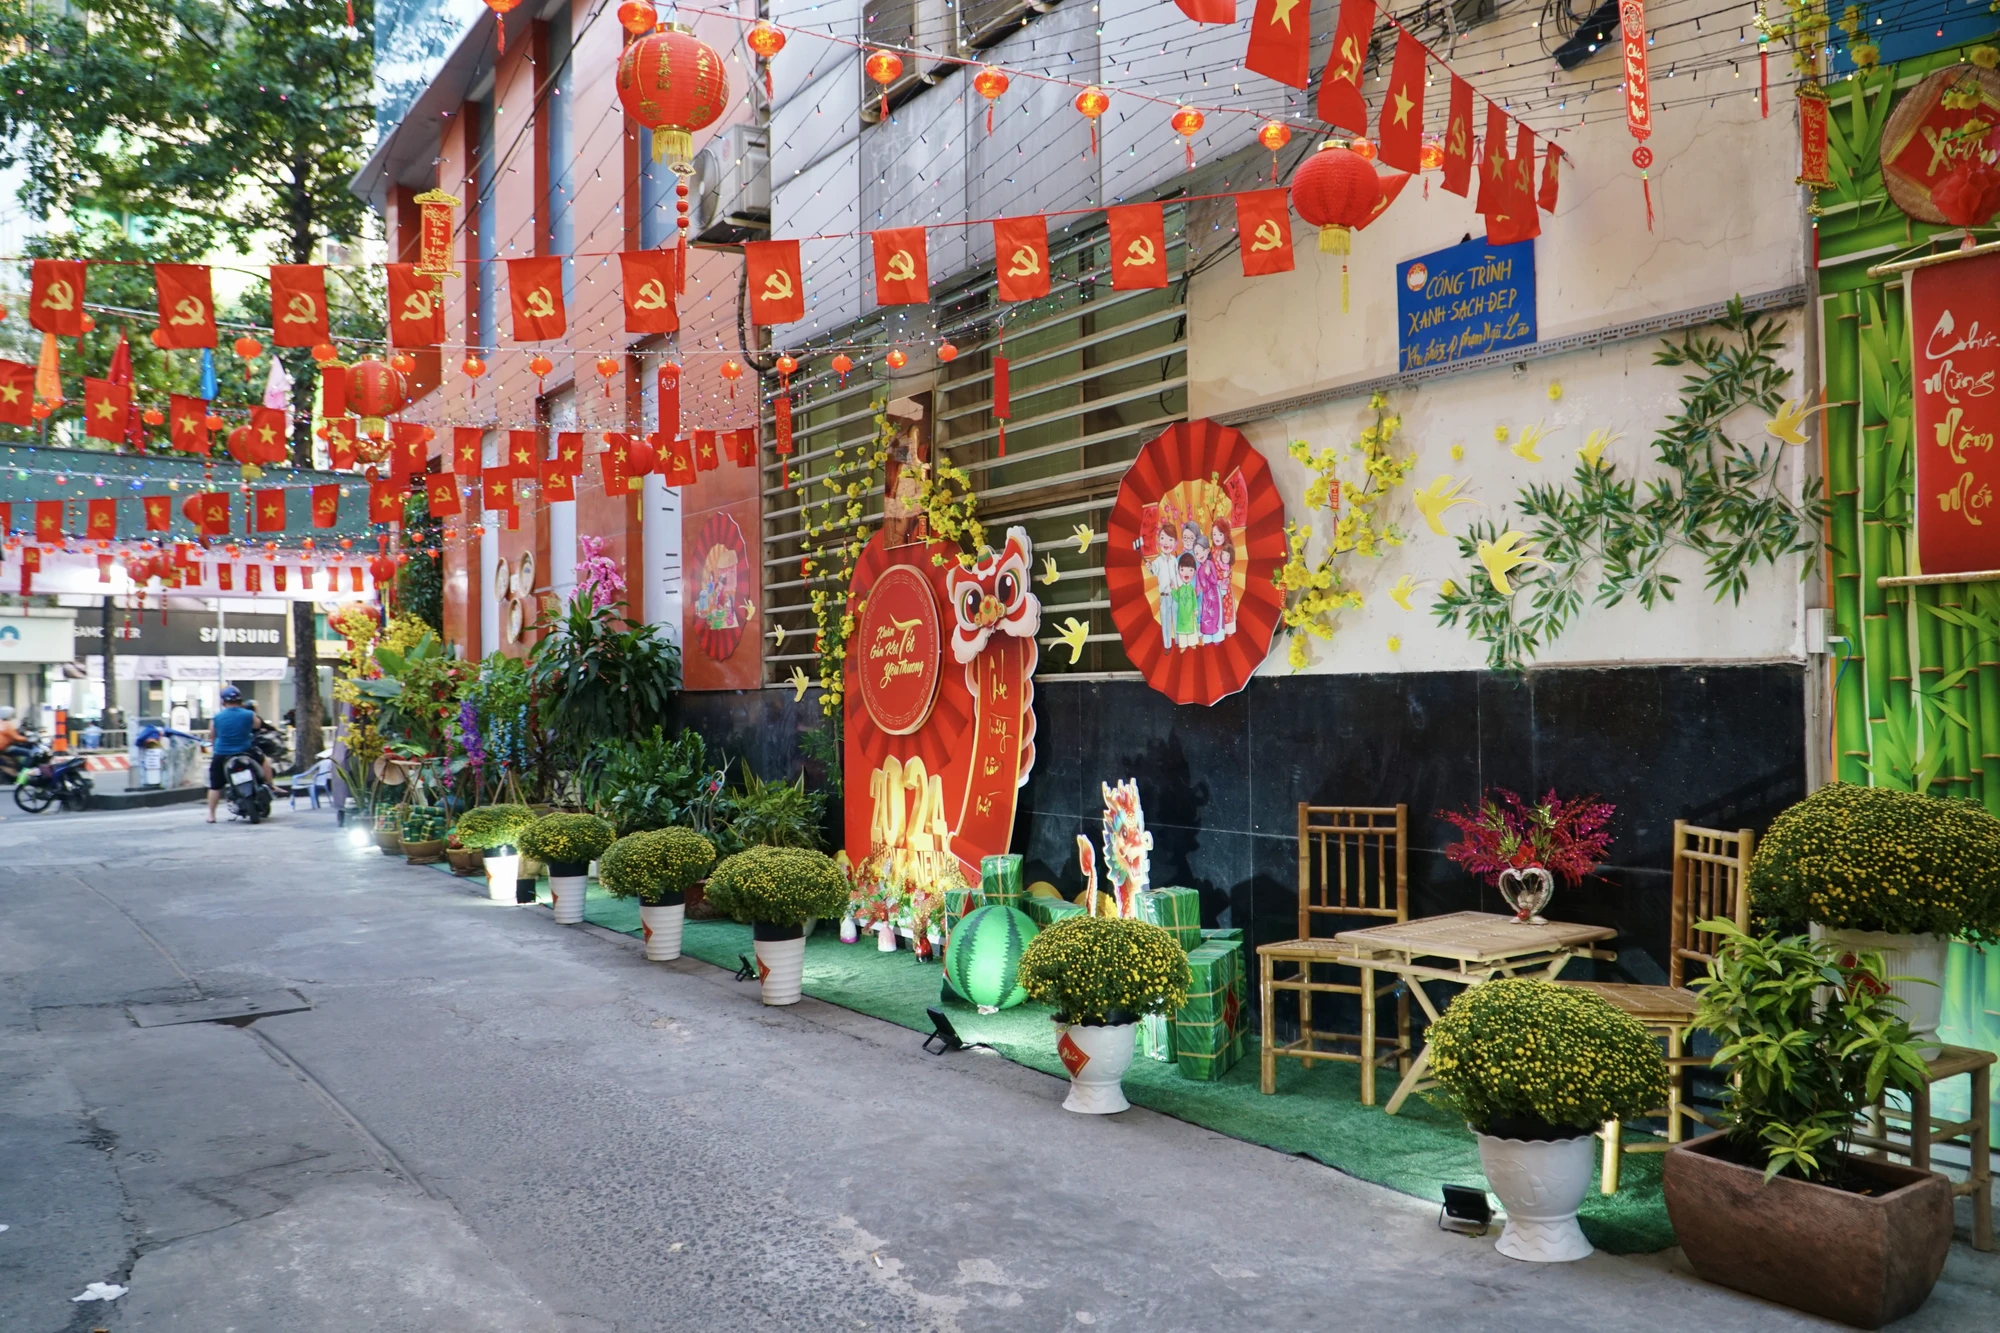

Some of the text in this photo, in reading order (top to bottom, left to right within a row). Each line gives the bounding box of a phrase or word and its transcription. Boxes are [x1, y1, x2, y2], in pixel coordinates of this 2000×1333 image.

[74, 625, 280, 644] SAMCNTER SAMSUNG
[869, 754, 949, 853] 2024
